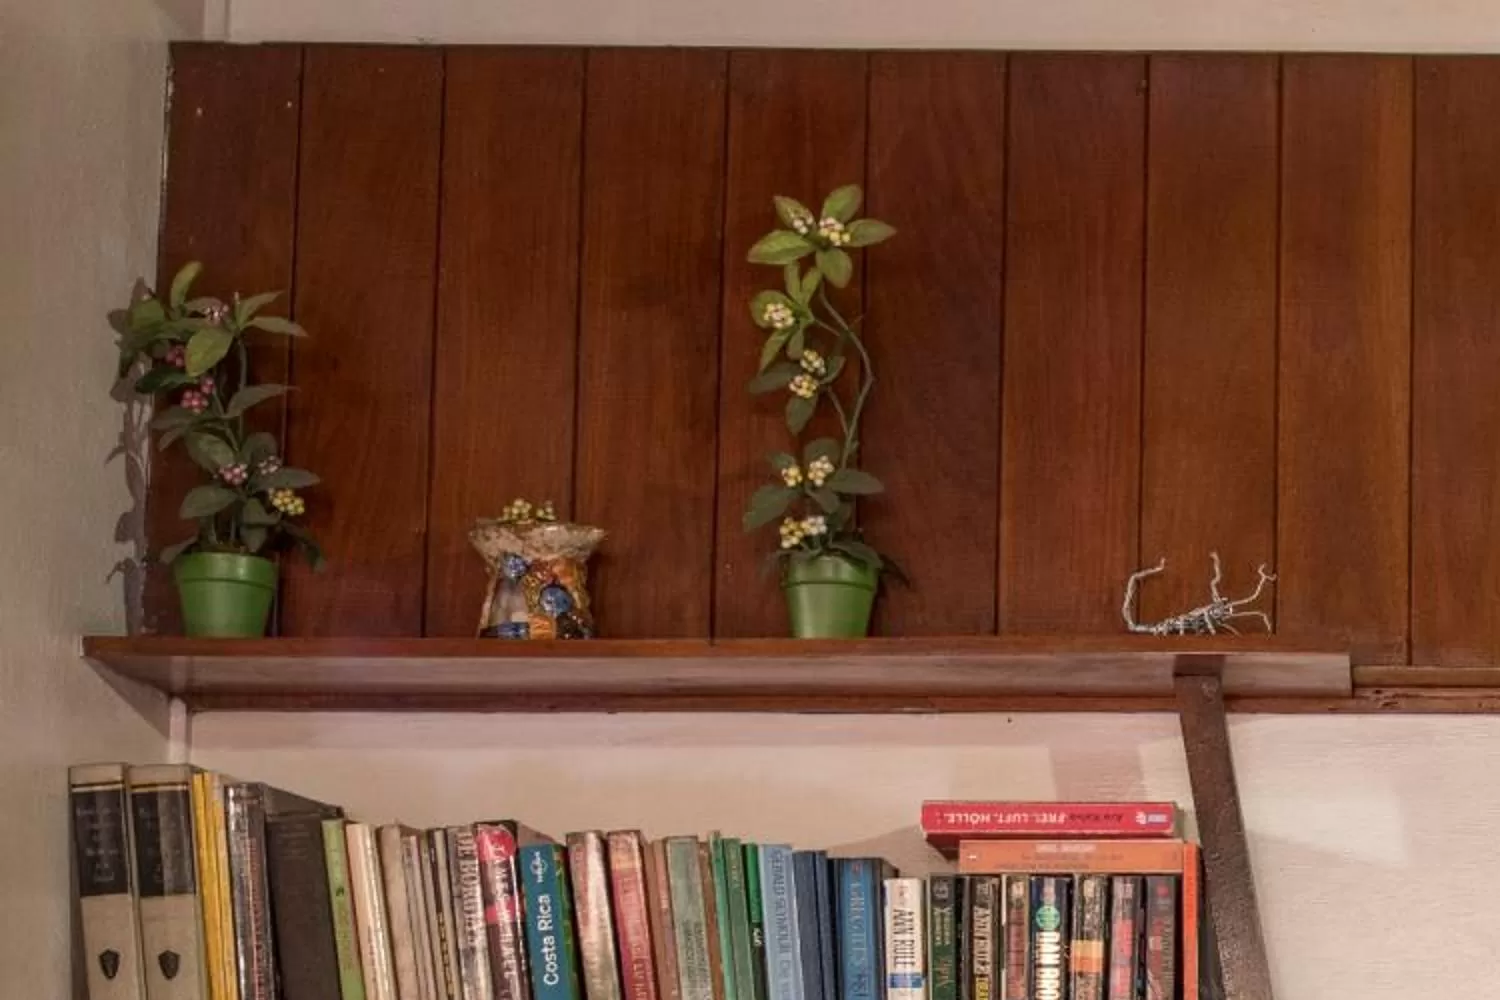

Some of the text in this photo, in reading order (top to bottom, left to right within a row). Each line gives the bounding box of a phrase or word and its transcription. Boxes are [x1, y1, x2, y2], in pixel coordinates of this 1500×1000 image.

[537, 894, 554, 932] Rica
[540, 936, 559, 986] Costa
[893, 909, 917, 970] ANN RULE
[974, 906, 992, 975] ANN RULE
[1036, 931, 1061, 964] DAN
